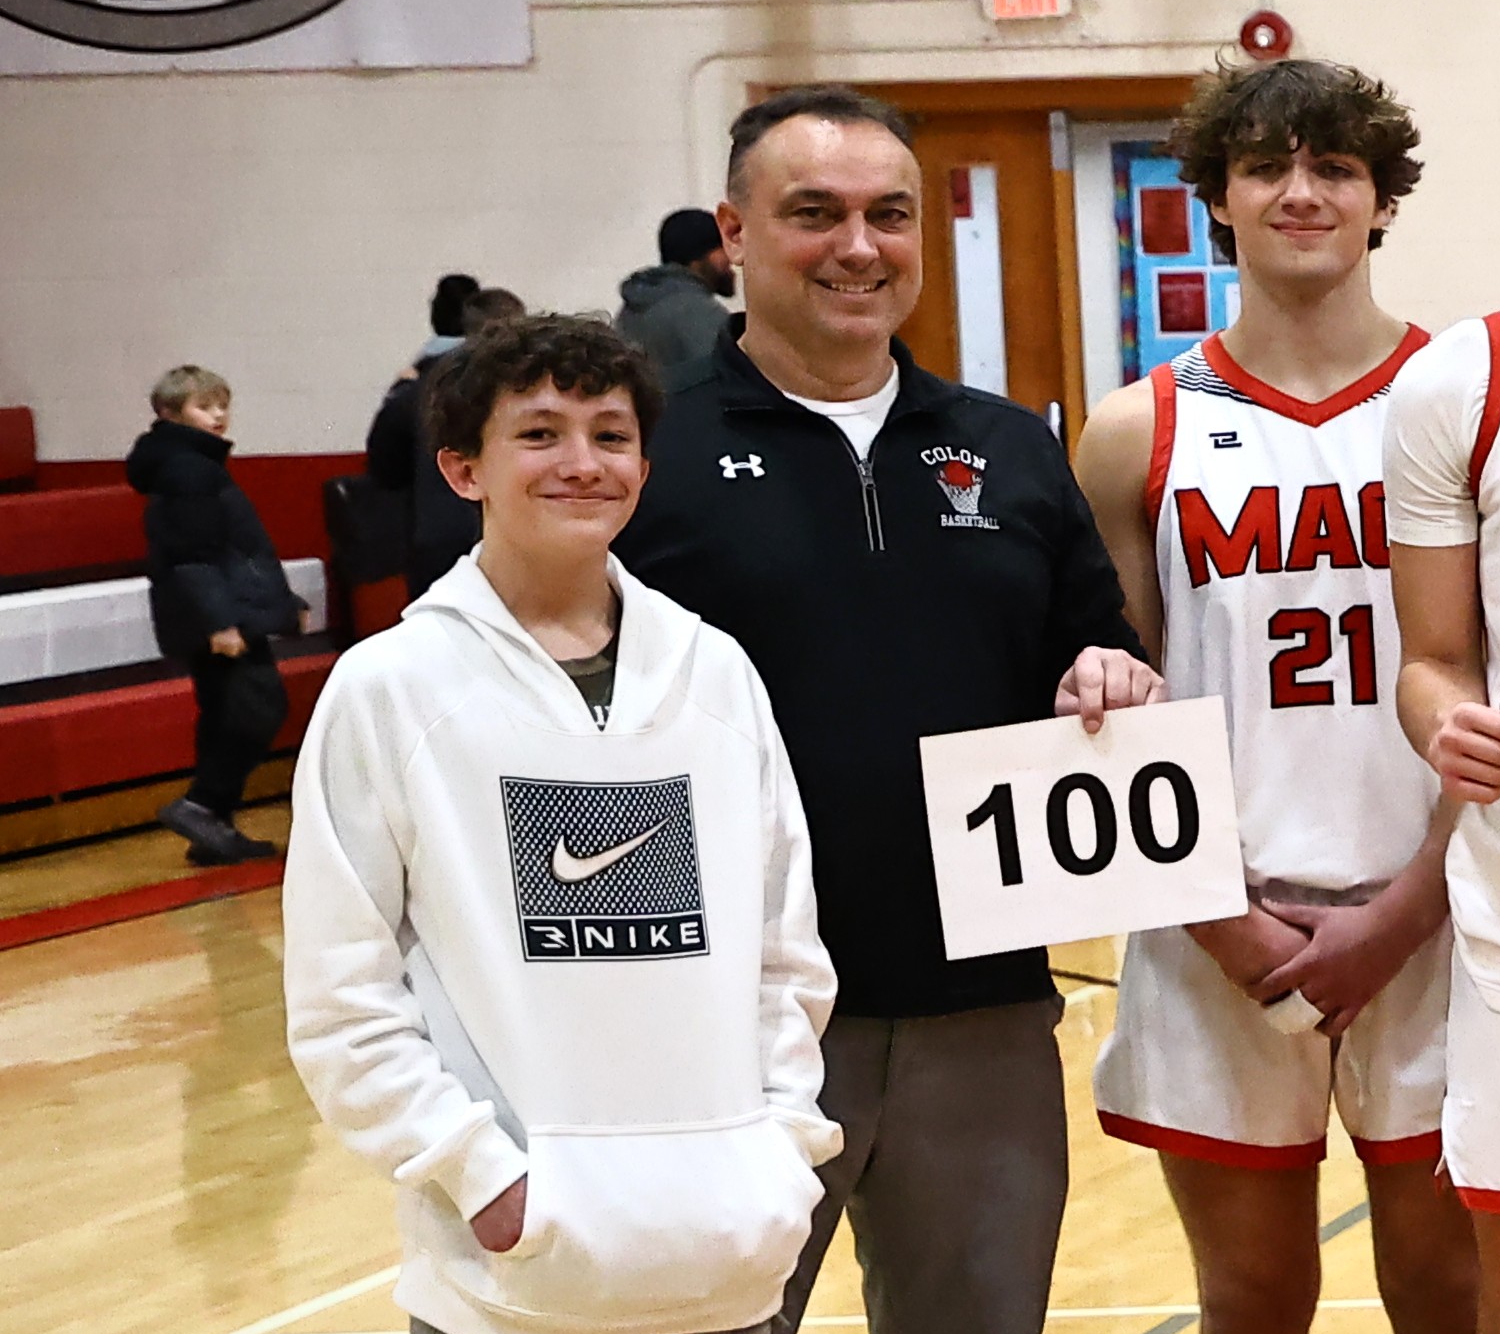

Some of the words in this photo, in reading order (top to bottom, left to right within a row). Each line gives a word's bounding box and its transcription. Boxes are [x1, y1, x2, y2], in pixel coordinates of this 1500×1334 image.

[920, 446, 988, 471] COLON
[940, 513, 1000, 530] BASKETBALL
[1268, 604, 1379, 710] 21
[965, 761, 1201, 887] 100
[584, 919, 702, 951] NIKE
